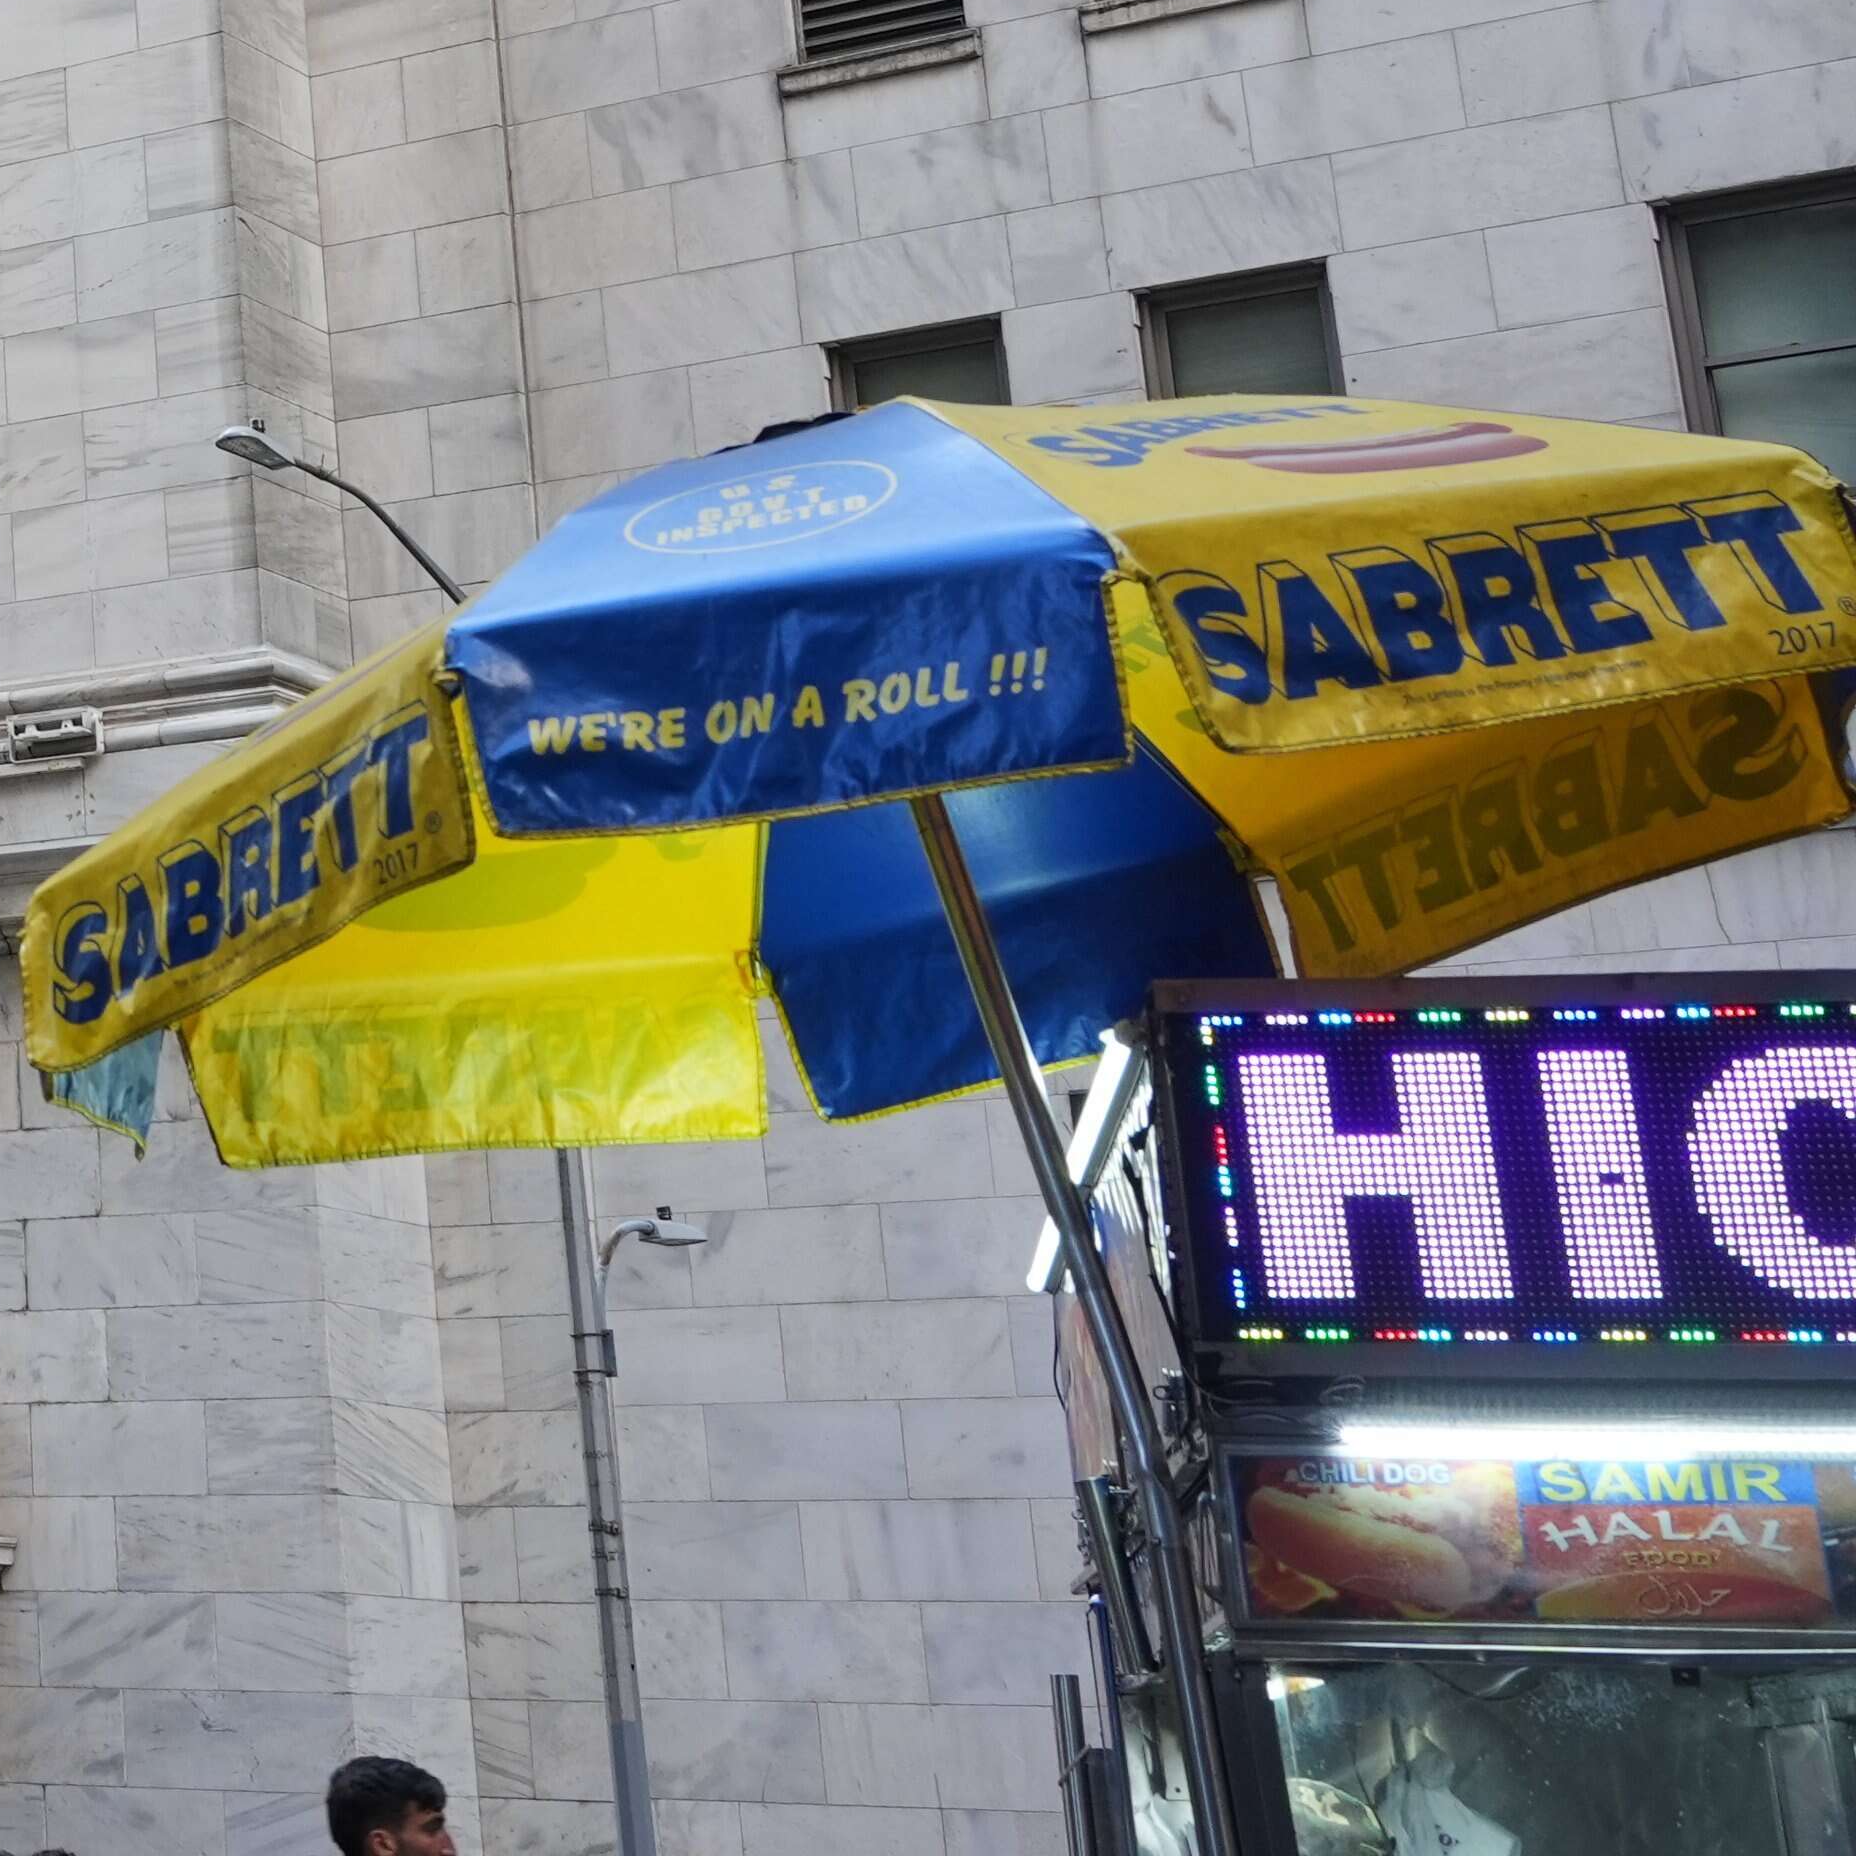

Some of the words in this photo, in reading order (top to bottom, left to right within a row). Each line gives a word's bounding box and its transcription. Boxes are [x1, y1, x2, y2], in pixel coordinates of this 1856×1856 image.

[1027, 403, 1371, 468] SABRETT
[656, 494, 869, 546] INSPECTED
[1158, 490, 1824, 705] SABRETT
[1767, 621, 1837, 655] 2017
[528, 707, 686, 755] WE'RE
[704, 692, 775, 744] ON
[792, 685, 825, 728] A
[842, 661, 969, 723] ROLL
[988, 647, 1048, 697] !!!
[52, 699, 429, 1025] SABRETT
[373, 844, 420, 886] 2017
[1298, 1461, 1377, 1484] CHILI
[1383, 1463, 1451, 1485] DOG
[1538, 1462, 1788, 1502] SAMIR
[1539, 1510, 1793, 1553] HALAL
[1624, 1550, 1713, 1568] FOOD
